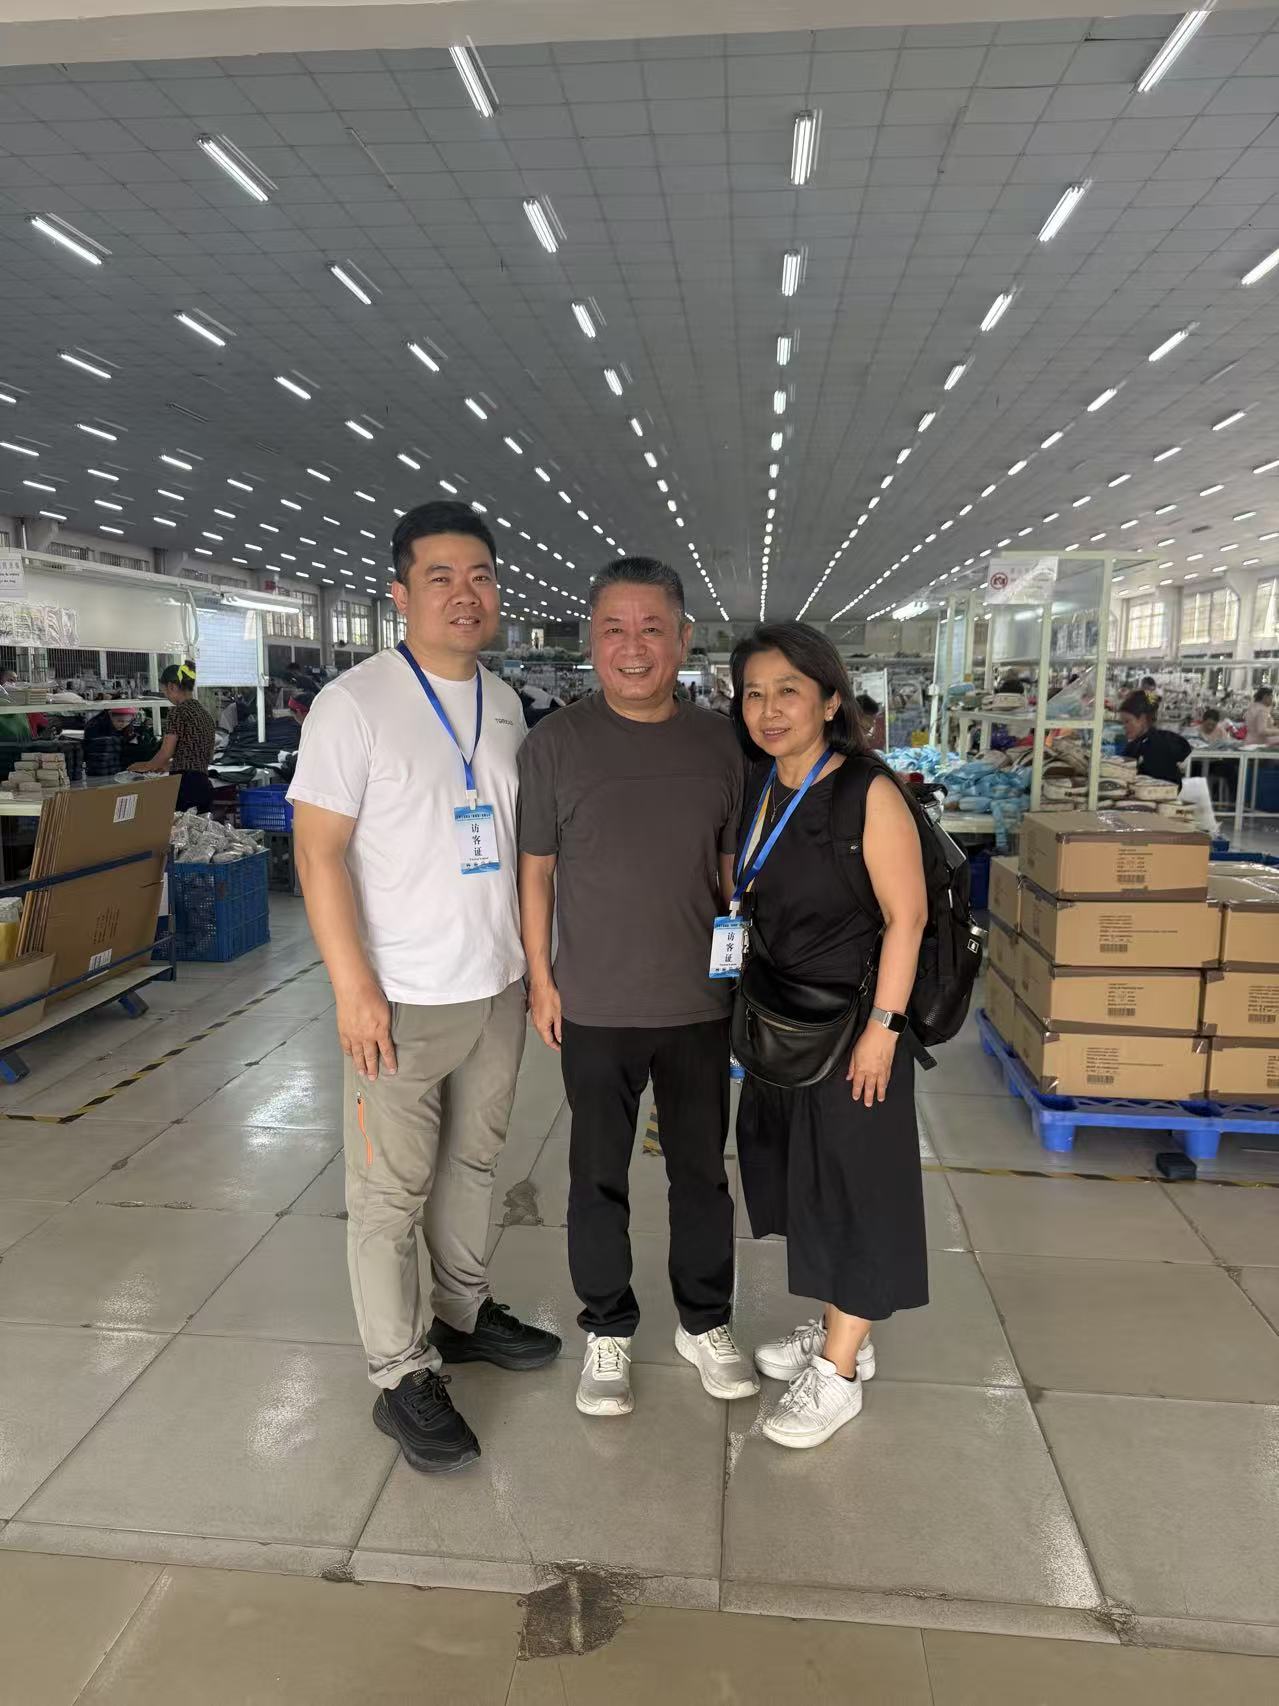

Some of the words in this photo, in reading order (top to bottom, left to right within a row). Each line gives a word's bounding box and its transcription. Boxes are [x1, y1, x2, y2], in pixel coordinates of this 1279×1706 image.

[471, 823, 482, 856] 访客证
[725, 932, 735, 962] 访客证
